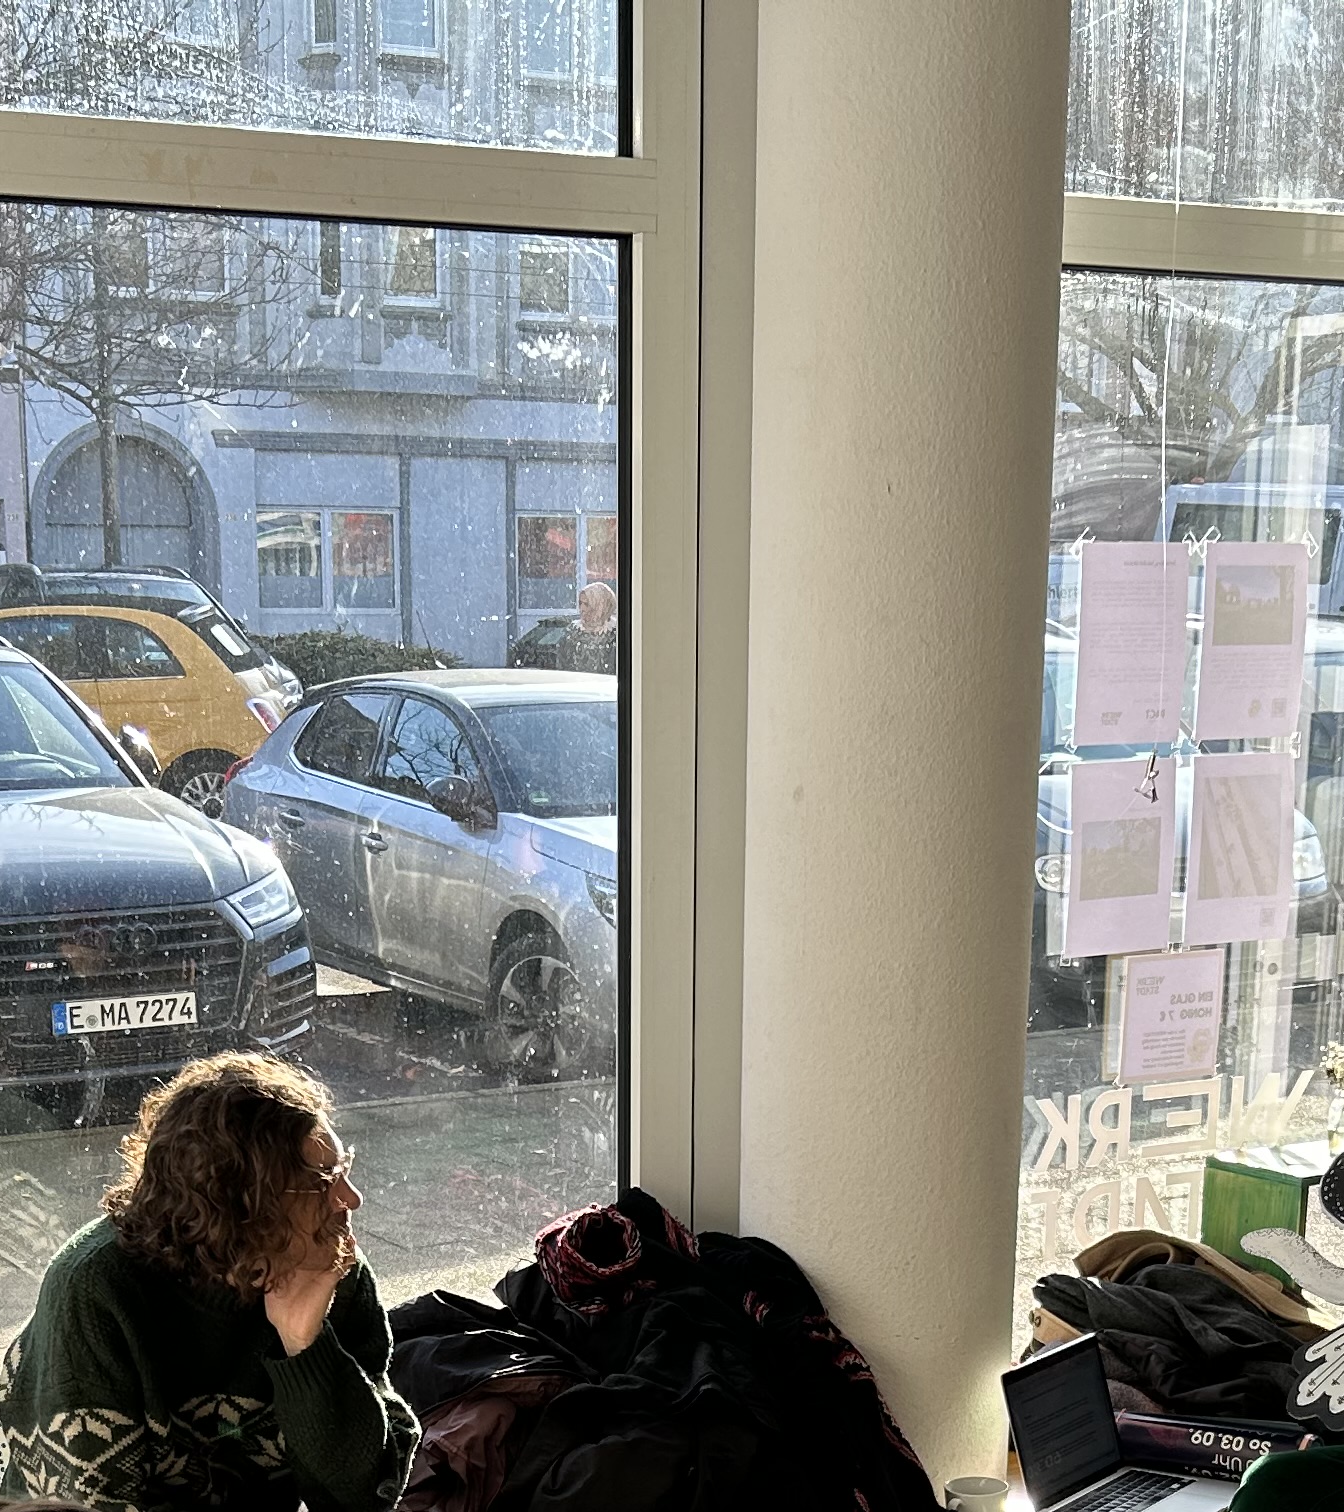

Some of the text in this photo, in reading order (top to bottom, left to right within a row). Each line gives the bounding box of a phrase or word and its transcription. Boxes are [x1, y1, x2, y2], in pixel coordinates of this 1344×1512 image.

[69, 996, 193, 1029] E MA 7274
[1249, 1438, 1272, 1456] So
[1211, 1453, 1243, 1472] Uhr
